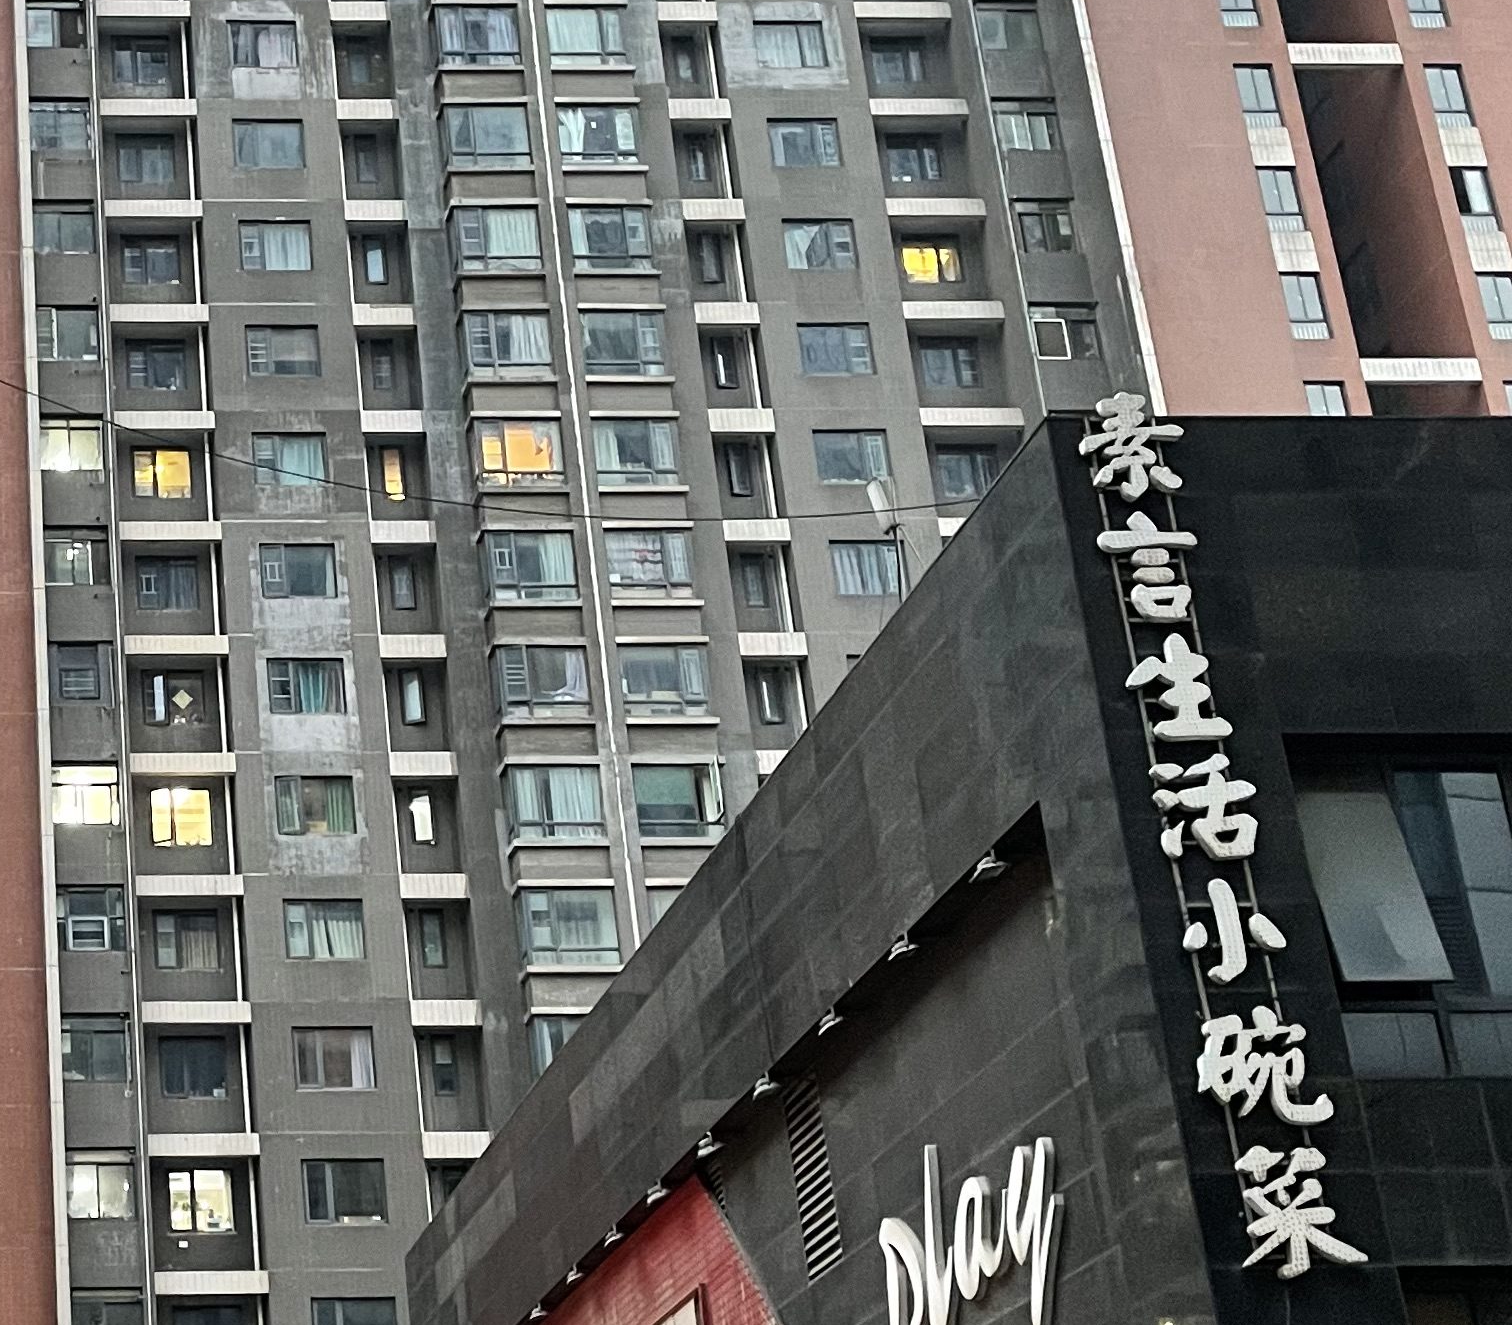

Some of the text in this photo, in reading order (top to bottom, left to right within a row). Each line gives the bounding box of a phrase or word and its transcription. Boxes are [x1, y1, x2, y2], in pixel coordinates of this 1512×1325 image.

[1078, 391, 1369, 1278] 素言生活小碗菜
